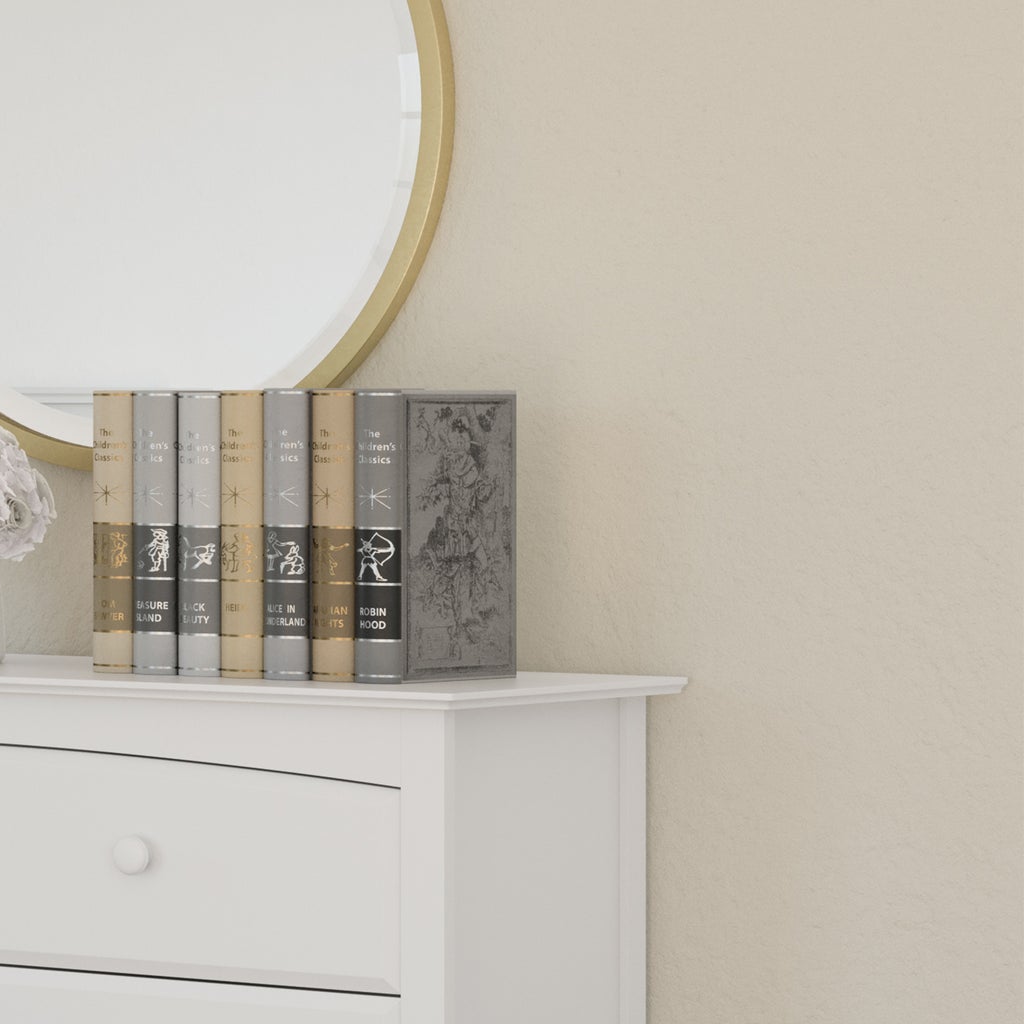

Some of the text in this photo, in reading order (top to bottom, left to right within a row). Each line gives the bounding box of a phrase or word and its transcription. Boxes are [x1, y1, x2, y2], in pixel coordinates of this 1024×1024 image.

[363, 428, 381, 438] The
[357, 441, 397, 451] hildren's
[358, 454, 391, 465] Classics
[182, 602, 206, 612] LACK
[286, 604, 296, 614] IN
[359, 607, 387, 617] ROBIN
[359, 620, 387, 630] HOOD
